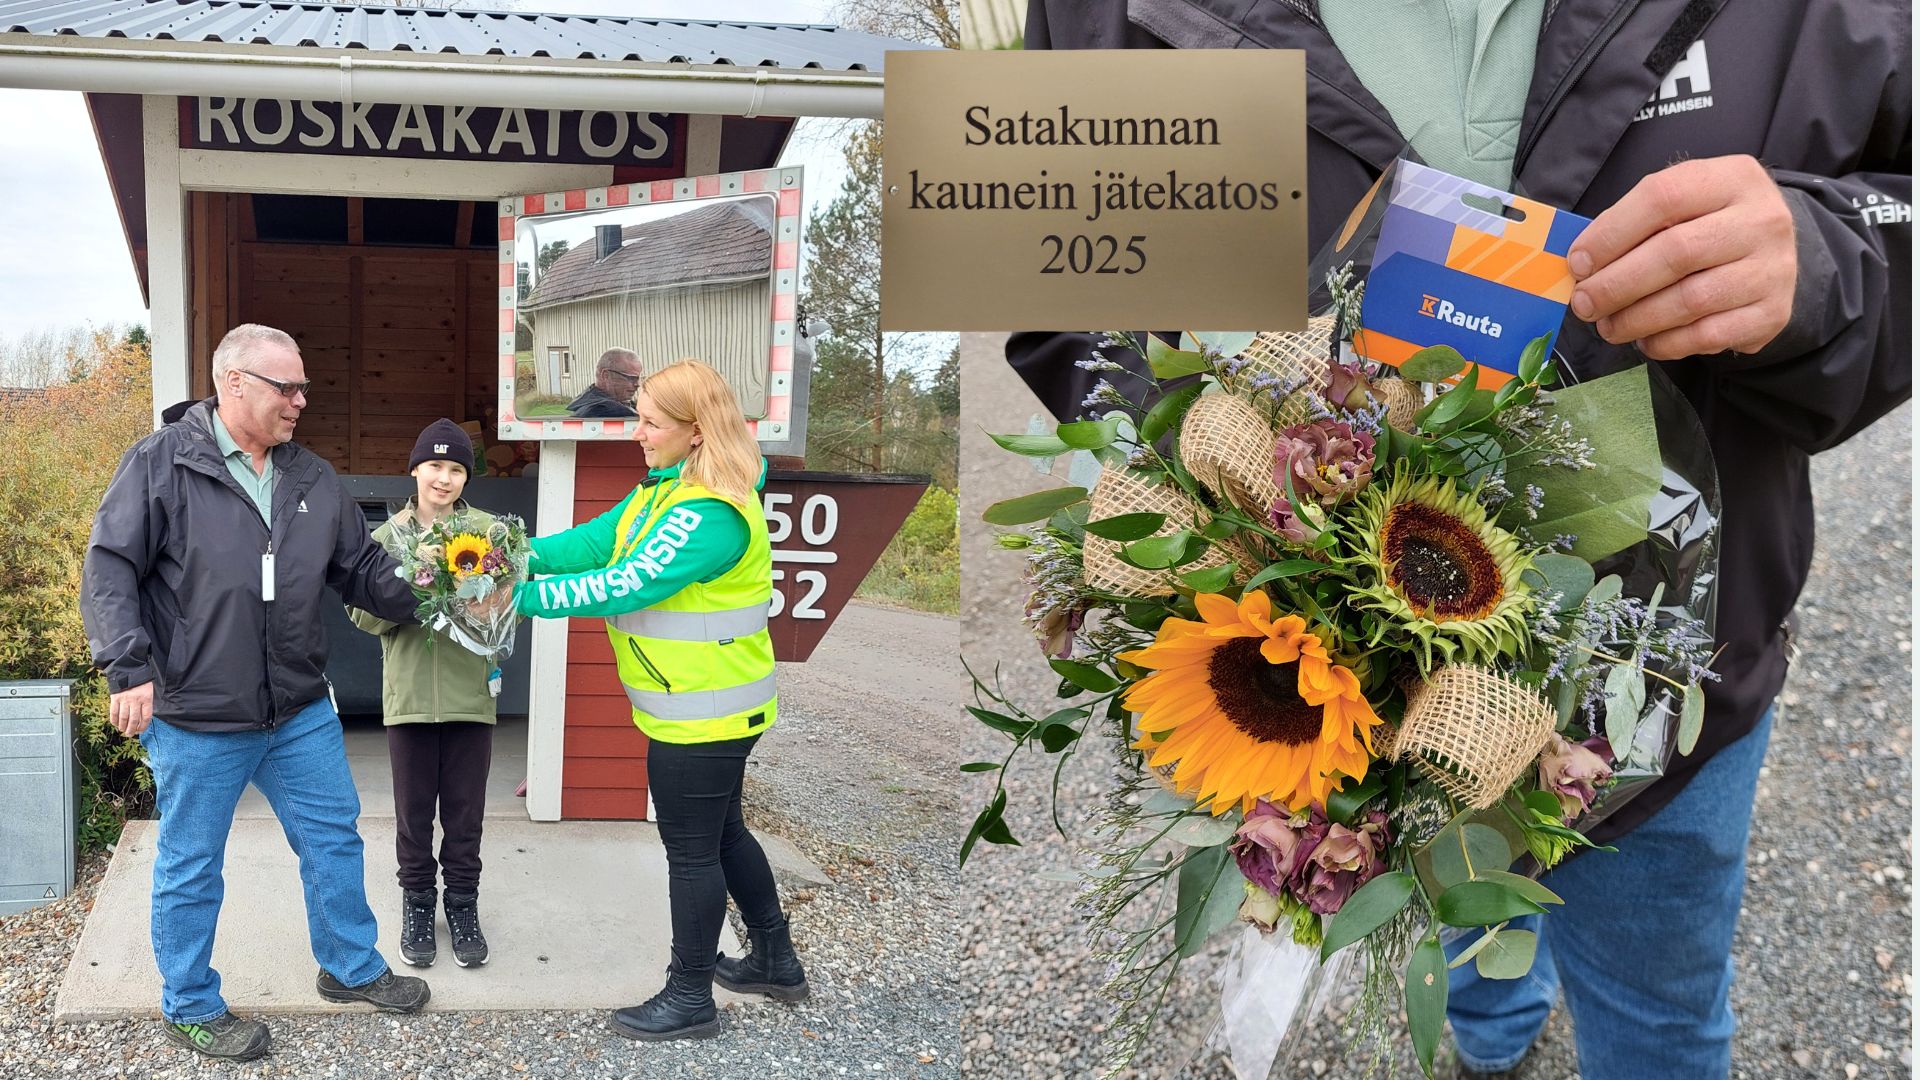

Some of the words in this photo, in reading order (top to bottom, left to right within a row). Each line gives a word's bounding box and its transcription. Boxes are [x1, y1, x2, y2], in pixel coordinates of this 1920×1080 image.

[964, 104, 1222, 146] Satakunnan
[1658, 95, 1714, 116] HANSEN
[198, 96, 669, 160] ROSKAKATOS
[907, 169, 1078, 211] kaunein
[1085, 169, 1280, 222] jätekatos
[1860, 203, 1912, 227] HELL
[1039, 234, 1148, 275] 2025
[1436, 300, 1503, 339] Rauta
[433, 443, 450, 454] CAT
[763, 493, 839, 546] 50
[538, 506, 703, 610] ROSKASAKKI
